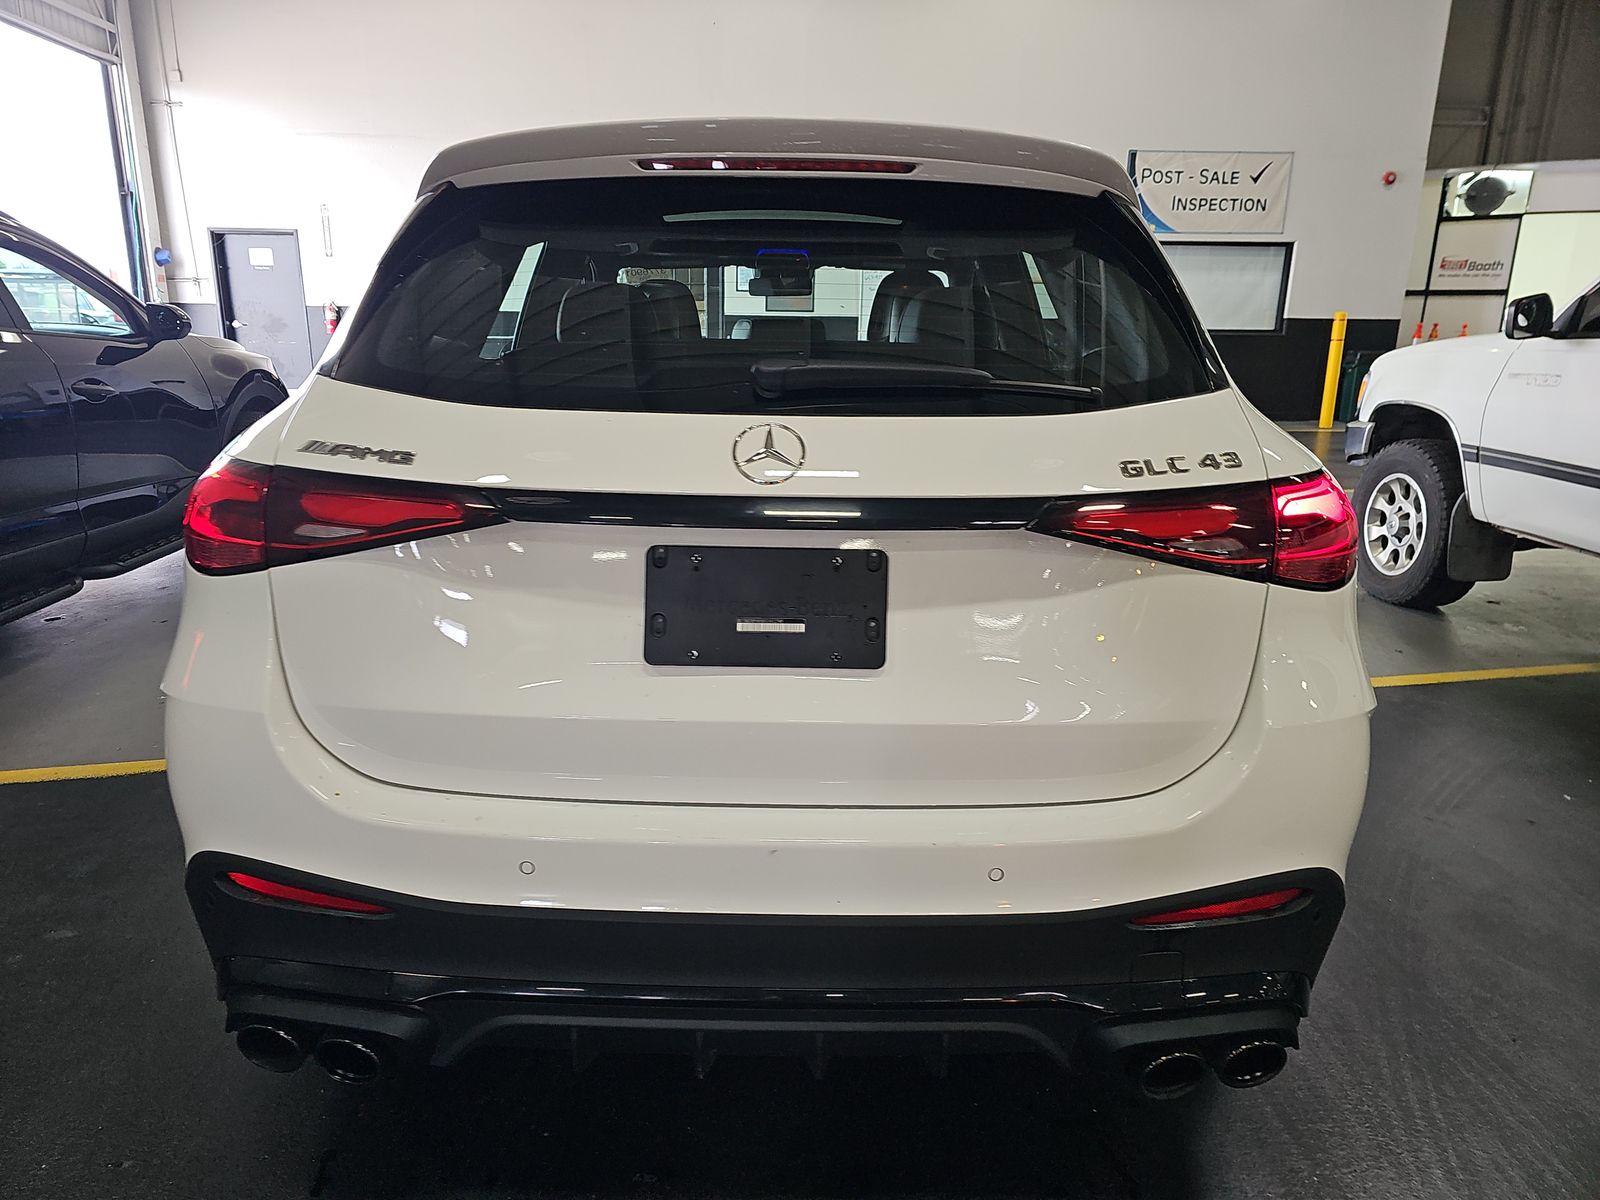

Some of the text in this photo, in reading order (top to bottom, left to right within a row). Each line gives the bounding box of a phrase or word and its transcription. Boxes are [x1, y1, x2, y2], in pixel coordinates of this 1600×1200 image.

[1141, 168, 1185, 184] POST
[1199, 168, 1241, 185] SALE
[1171, 195, 1268, 212] INSPECTION
[328, 443, 417, 466] AMG
[1119, 451, 1244, 479] GLC 43
